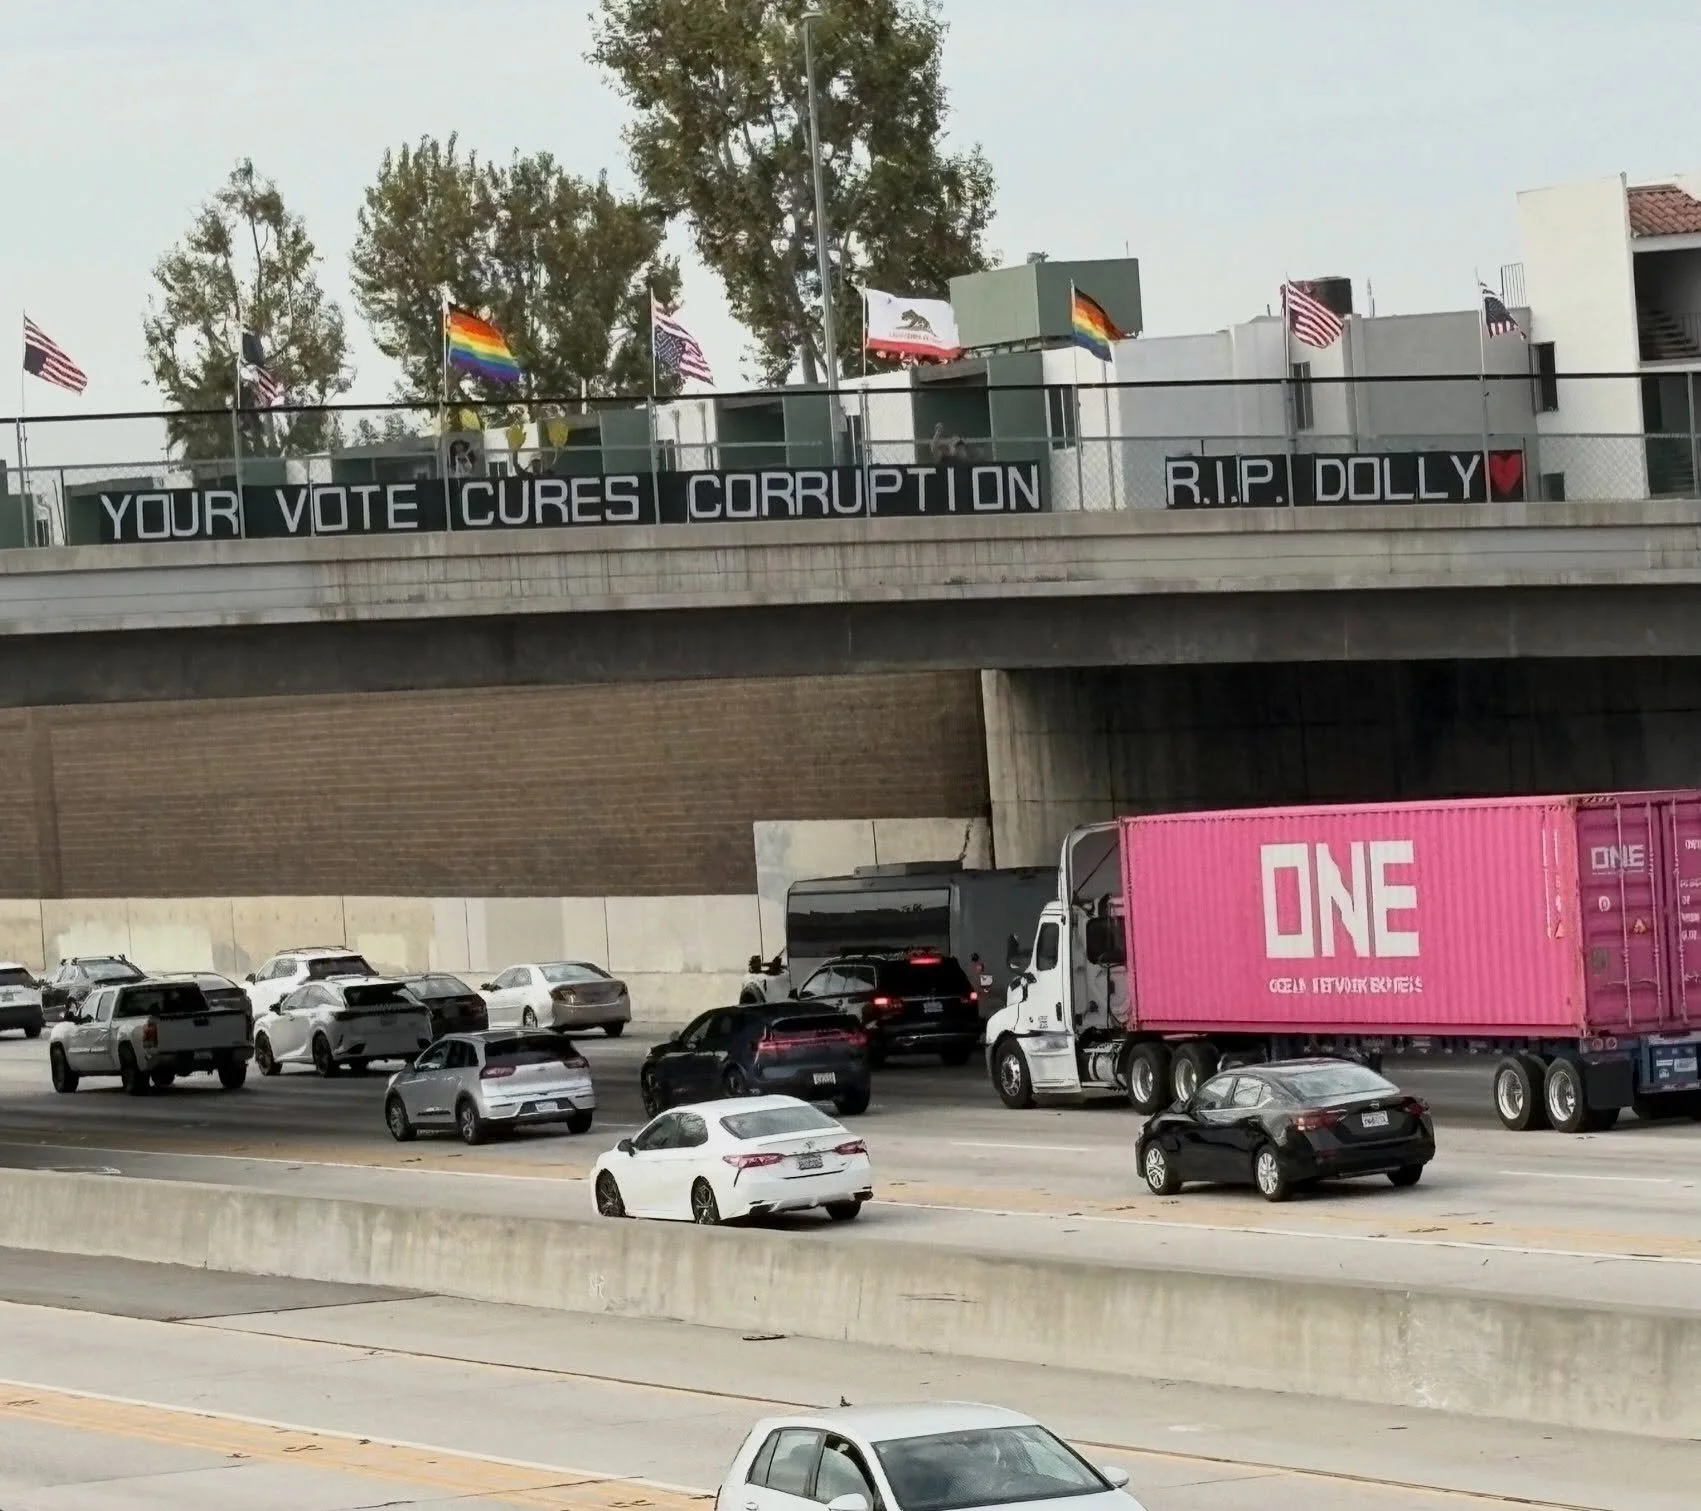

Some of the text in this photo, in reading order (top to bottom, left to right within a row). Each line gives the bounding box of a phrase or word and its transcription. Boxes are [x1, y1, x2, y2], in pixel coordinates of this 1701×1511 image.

[101, 464, 1040, 540] YOUR VOTE CURES CORRUPTION
[1167, 454, 1480, 506] R.I.P. DOLLY
[1590, 844, 1645, 870] ONE
[1260, 840, 1420, 959] ONE
